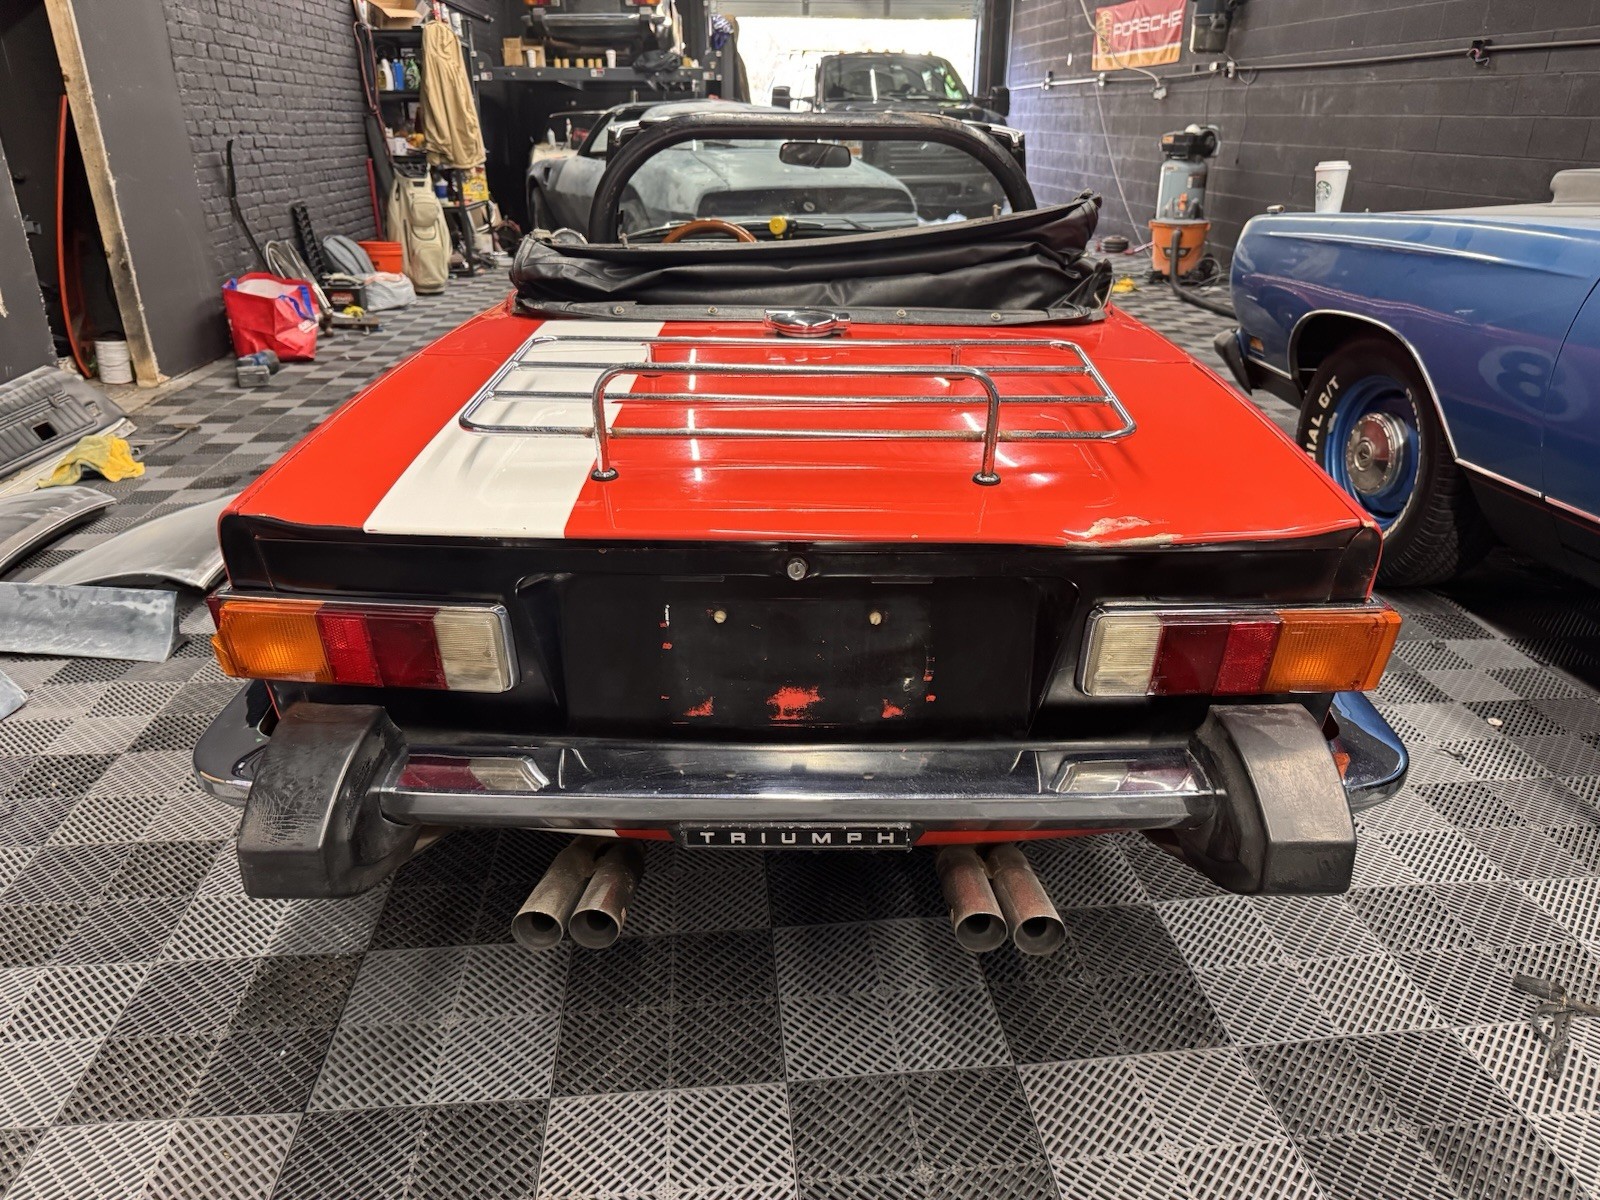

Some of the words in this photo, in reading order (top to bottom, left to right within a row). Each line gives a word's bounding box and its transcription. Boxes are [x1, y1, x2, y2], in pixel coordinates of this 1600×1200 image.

[1113, 9, 1183, 37] PORSCHE
[1318, 375, 1340, 409] G/T
[1497, 350, 1568, 415] 8
[700, 831, 894, 844] TRIUMPH
